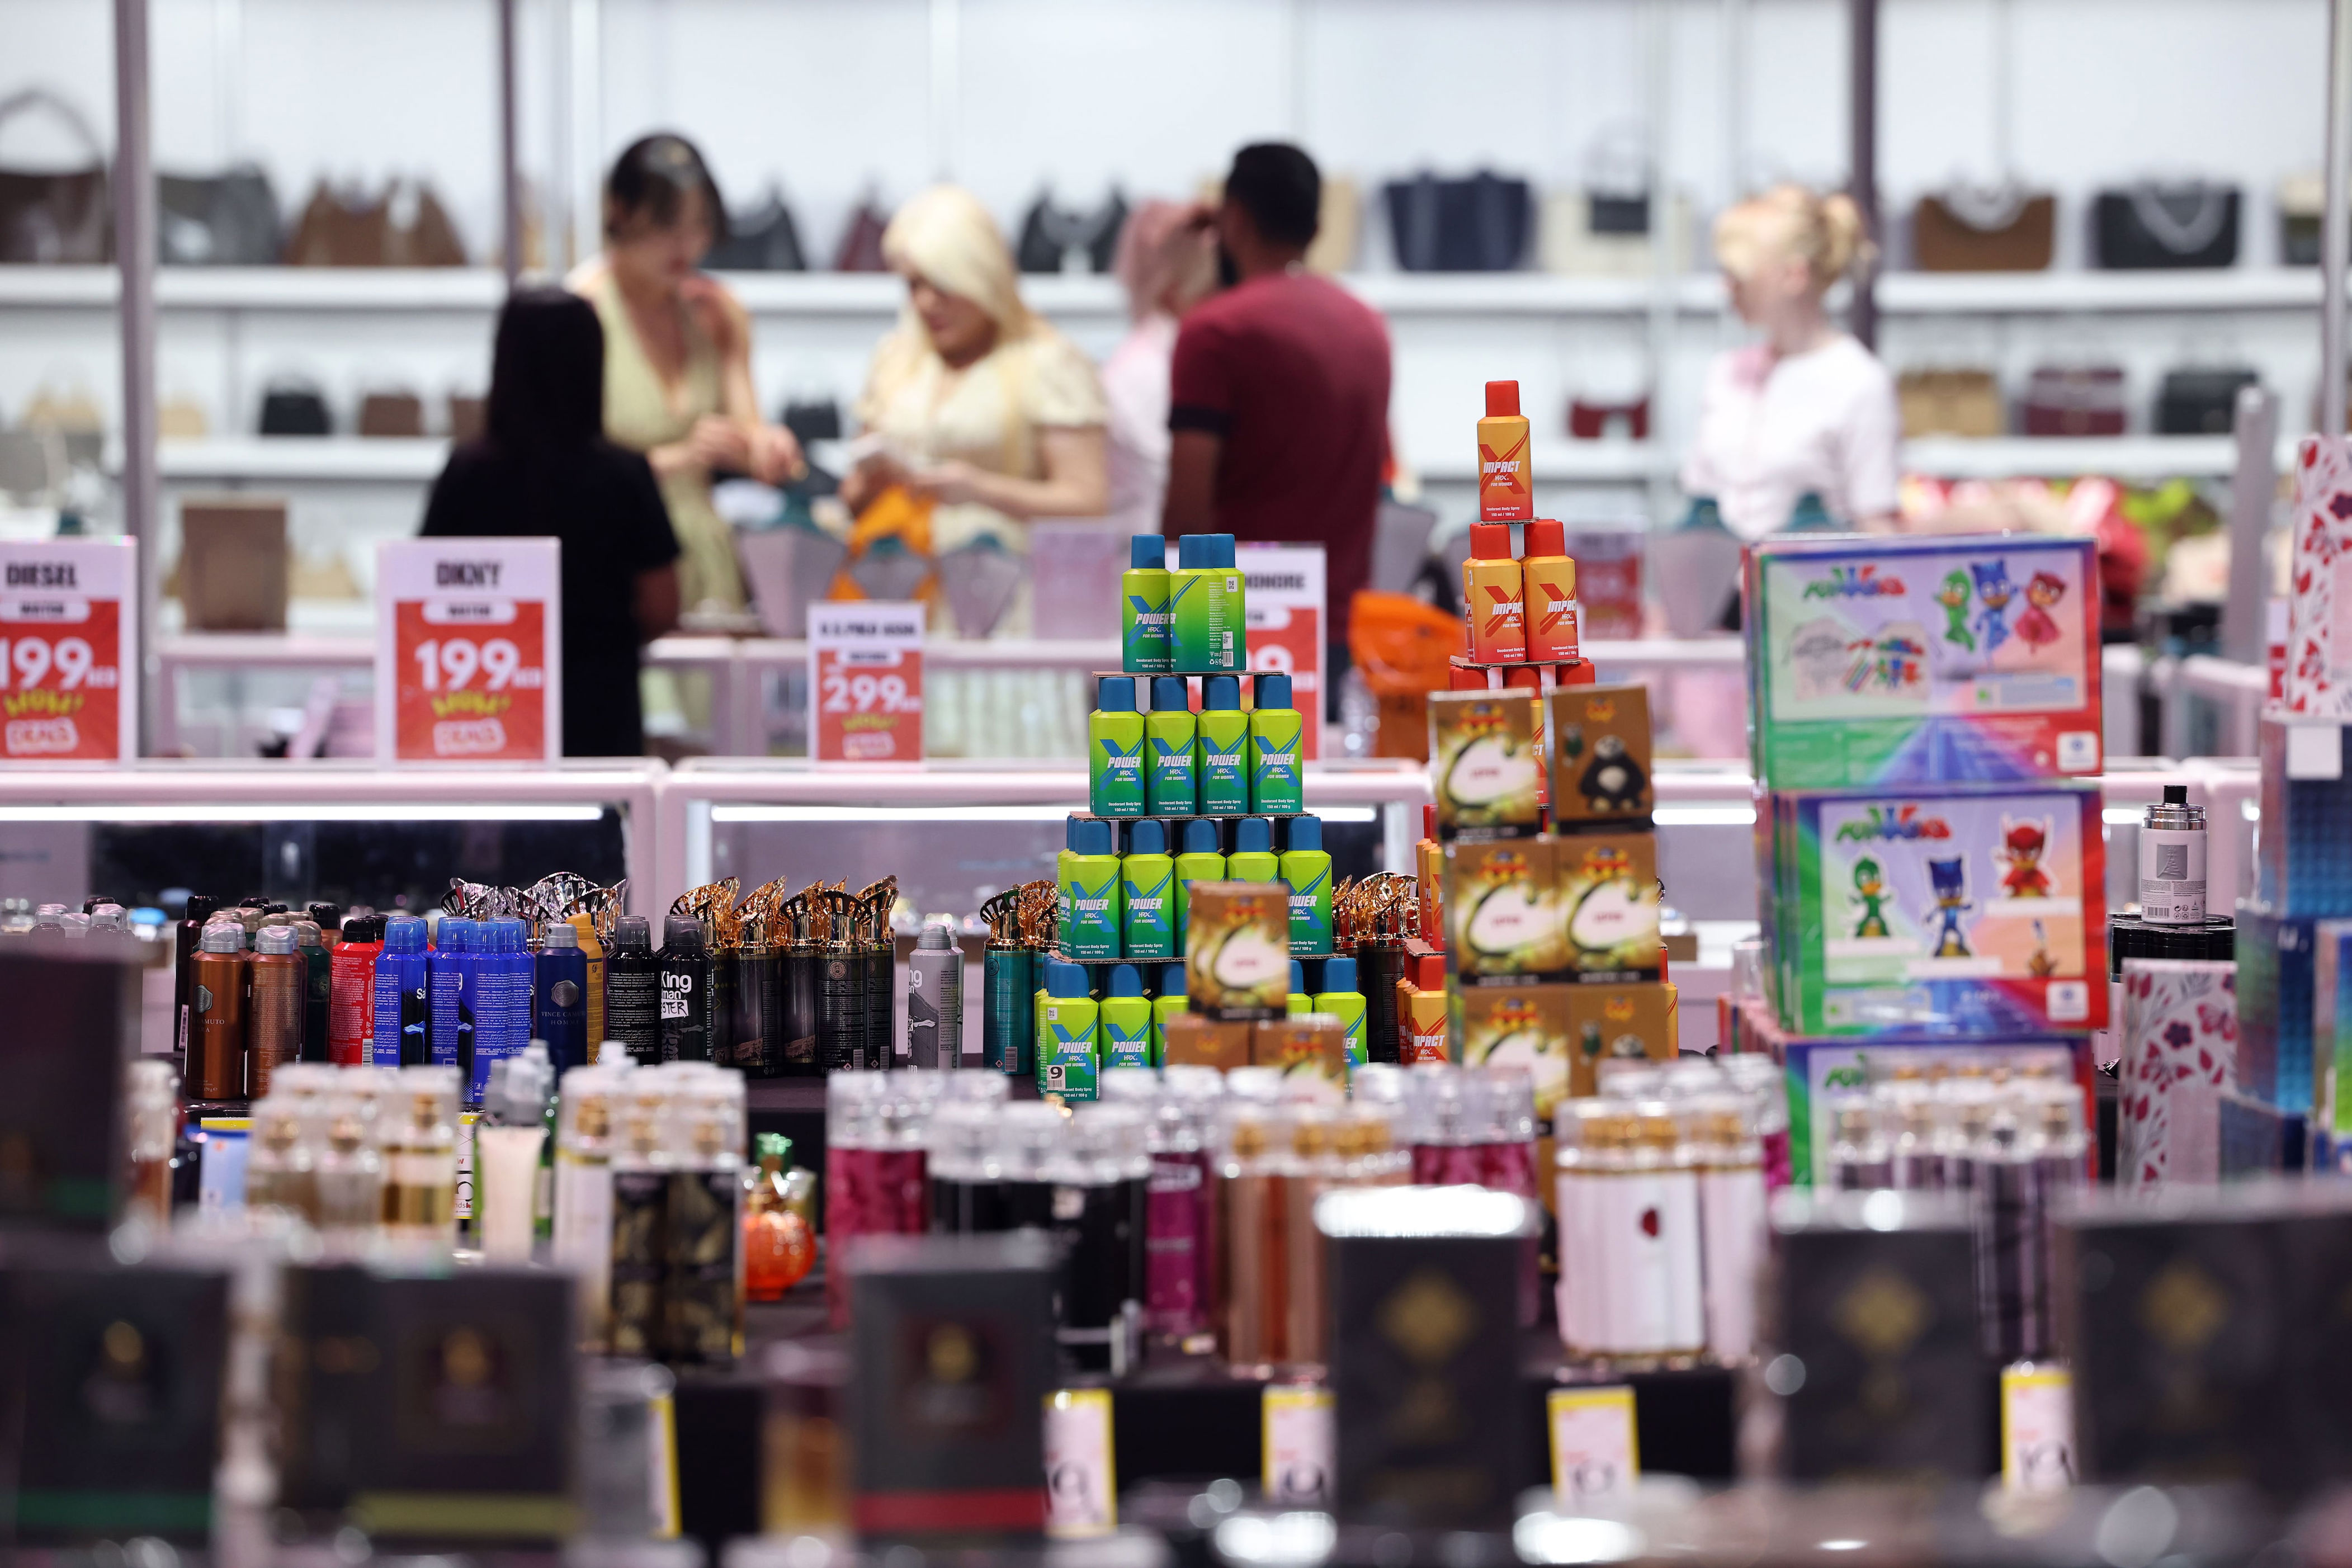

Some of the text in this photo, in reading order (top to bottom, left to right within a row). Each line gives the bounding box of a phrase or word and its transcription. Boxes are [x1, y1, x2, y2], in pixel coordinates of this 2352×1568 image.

[1483, 461, 1520, 473] IMPACT
[6, 564, 76, 586] DIESEL
[436, 562, 500, 586] DKNY
[1135, 613, 1169, 625] POWER
[0, 636, 93, 690] 199
[414, 638, 520, 691] 199
[823, 674, 906, 713] 299
[1107, 757, 1141, 768] POWER
[1157, 755, 1192, 767] POWER
[1206, 754, 1241, 766] POWER
[1260, 754, 1295, 766] POWER
[1075, 899, 1109, 910] POWER
[1128, 898, 1163, 910] POWER
[1057, 1042, 1092, 1053] POWER
[1111, 1041, 1146, 1052] POWER
[1050, 1066, 1062, 1079] 9
